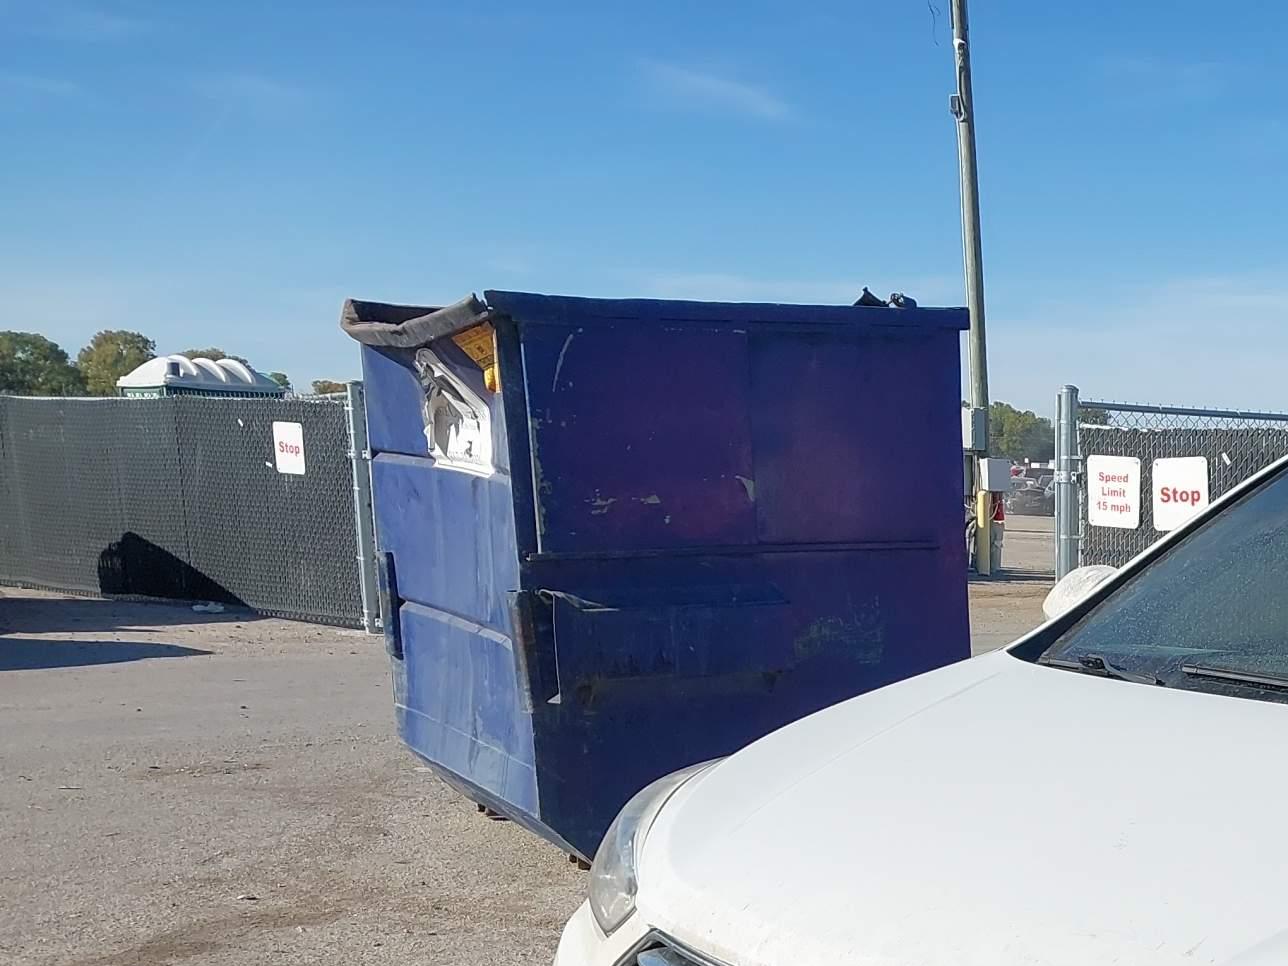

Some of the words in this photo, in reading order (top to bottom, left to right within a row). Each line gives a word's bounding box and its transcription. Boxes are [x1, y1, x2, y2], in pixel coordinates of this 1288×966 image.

[279, 441, 300, 457] Stop
[1098, 472, 1129, 483] Speed
[1101, 487, 1126, 498] Limit
[1160, 487, 1201, 506] Stop
[1096, 501, 1108, 511] 15
[1111, 503, 1131, 514] mph
